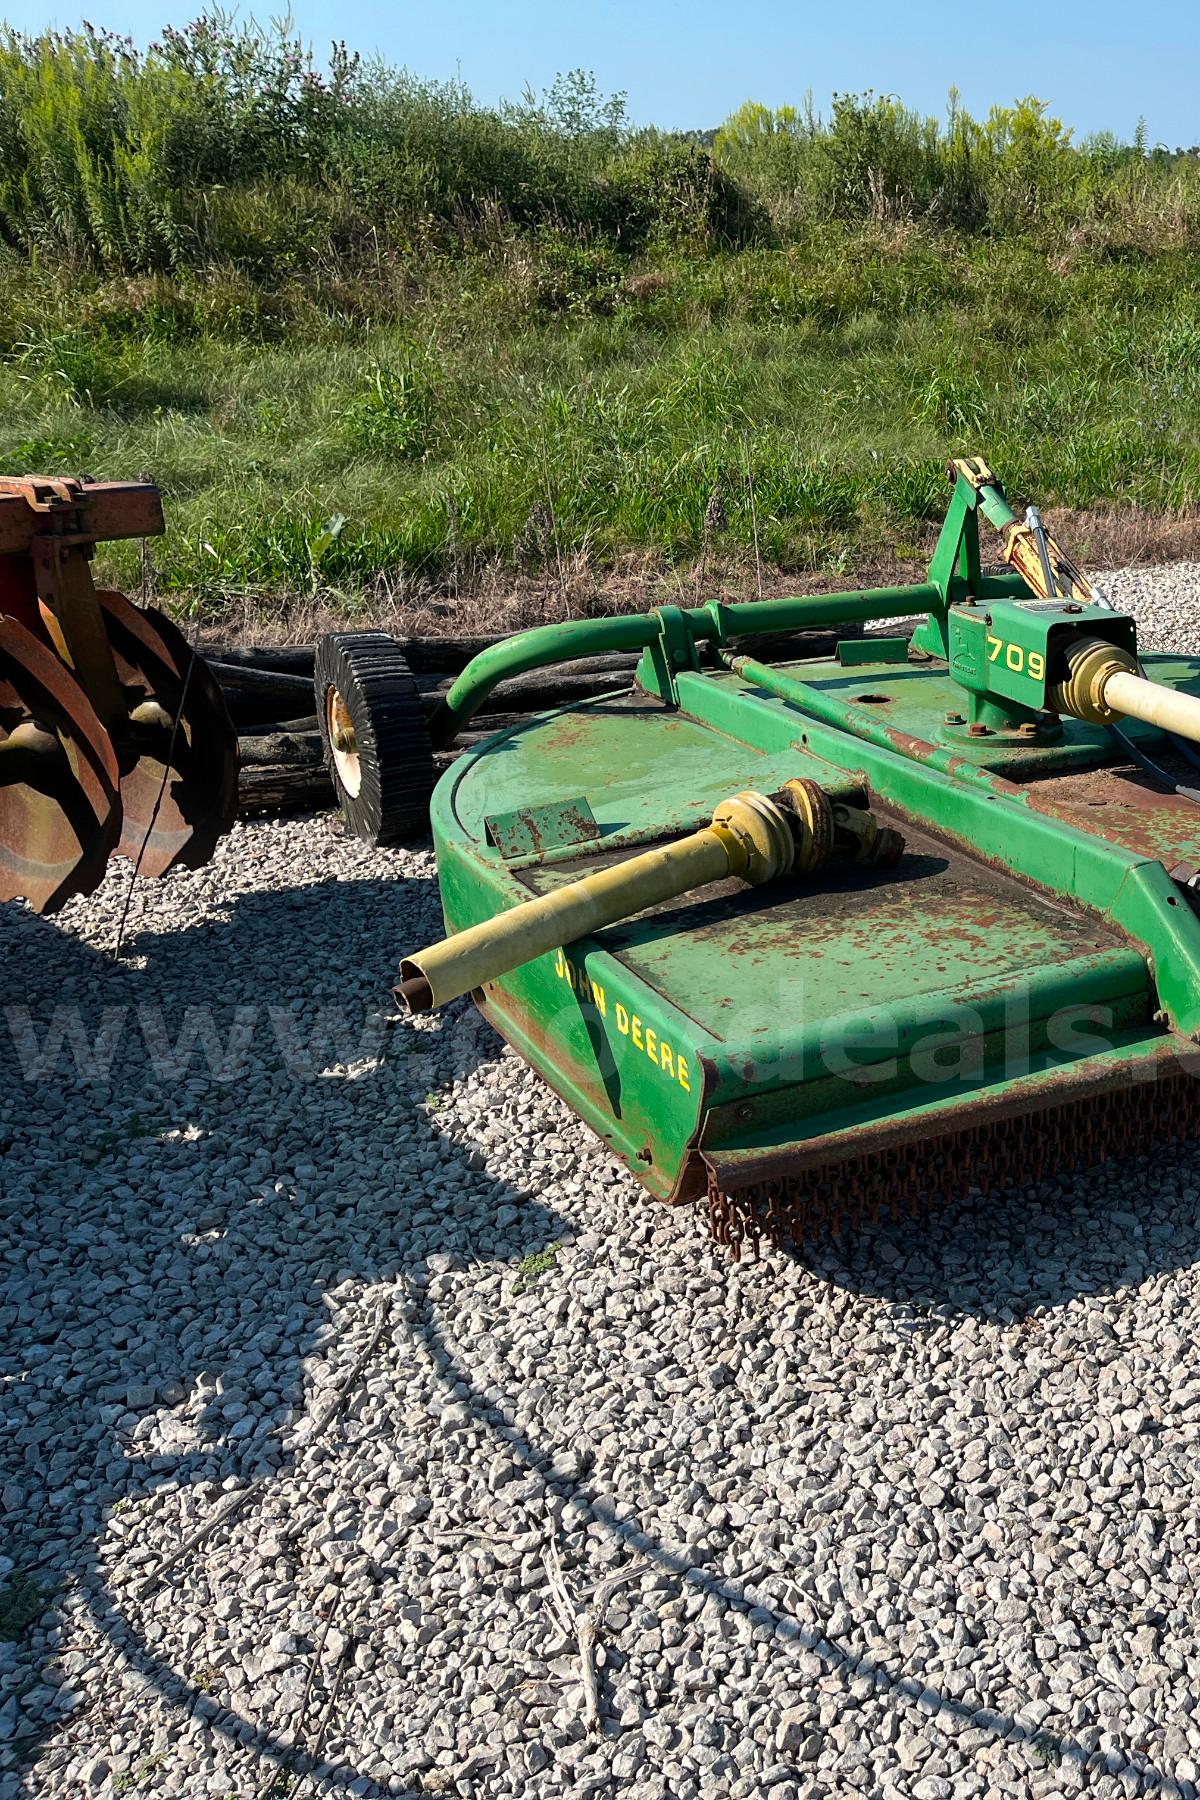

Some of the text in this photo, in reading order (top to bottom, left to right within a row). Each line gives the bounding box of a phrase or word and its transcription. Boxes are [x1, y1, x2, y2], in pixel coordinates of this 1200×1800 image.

[987, 636, 1045, 681] 709
[555, 949, 691, 1092] JOHN DEERE
